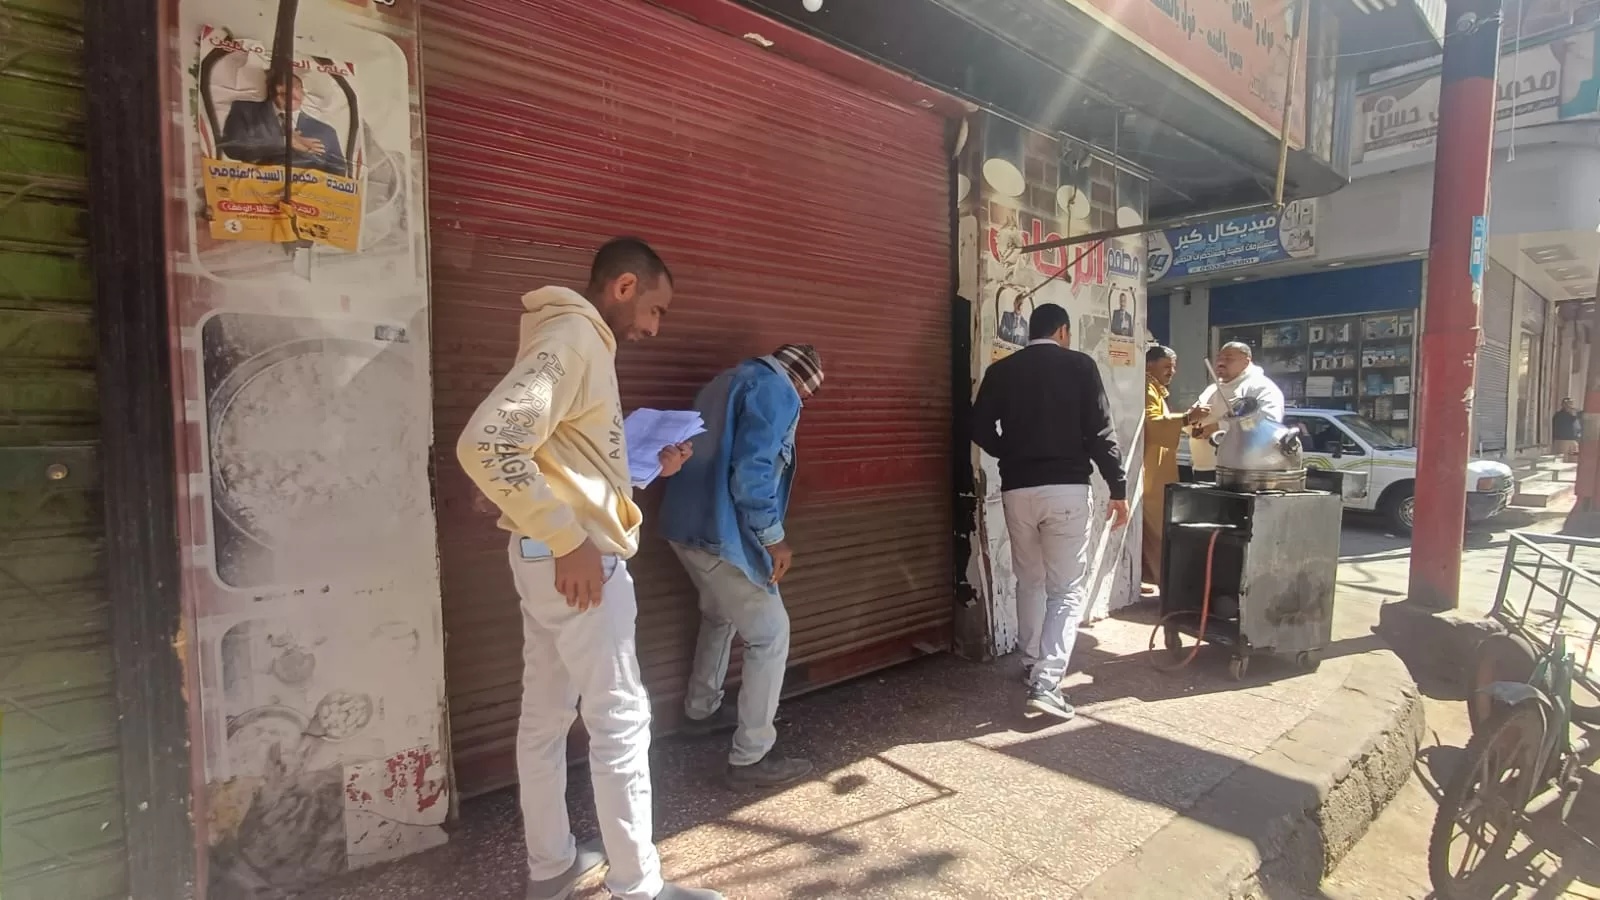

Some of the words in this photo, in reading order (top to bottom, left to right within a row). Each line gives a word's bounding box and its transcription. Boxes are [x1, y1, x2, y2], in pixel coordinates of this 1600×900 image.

[316, 64, 349, 77] على
[1496, 70, 1557, 101] محم
[1174, 228, 1203, 250] كير
[1209, 215, 1276, 243] ميديكال
[1106, 247, 1139, 281] مطعم
[477, 351, 550, 497] CALIFORNIA
